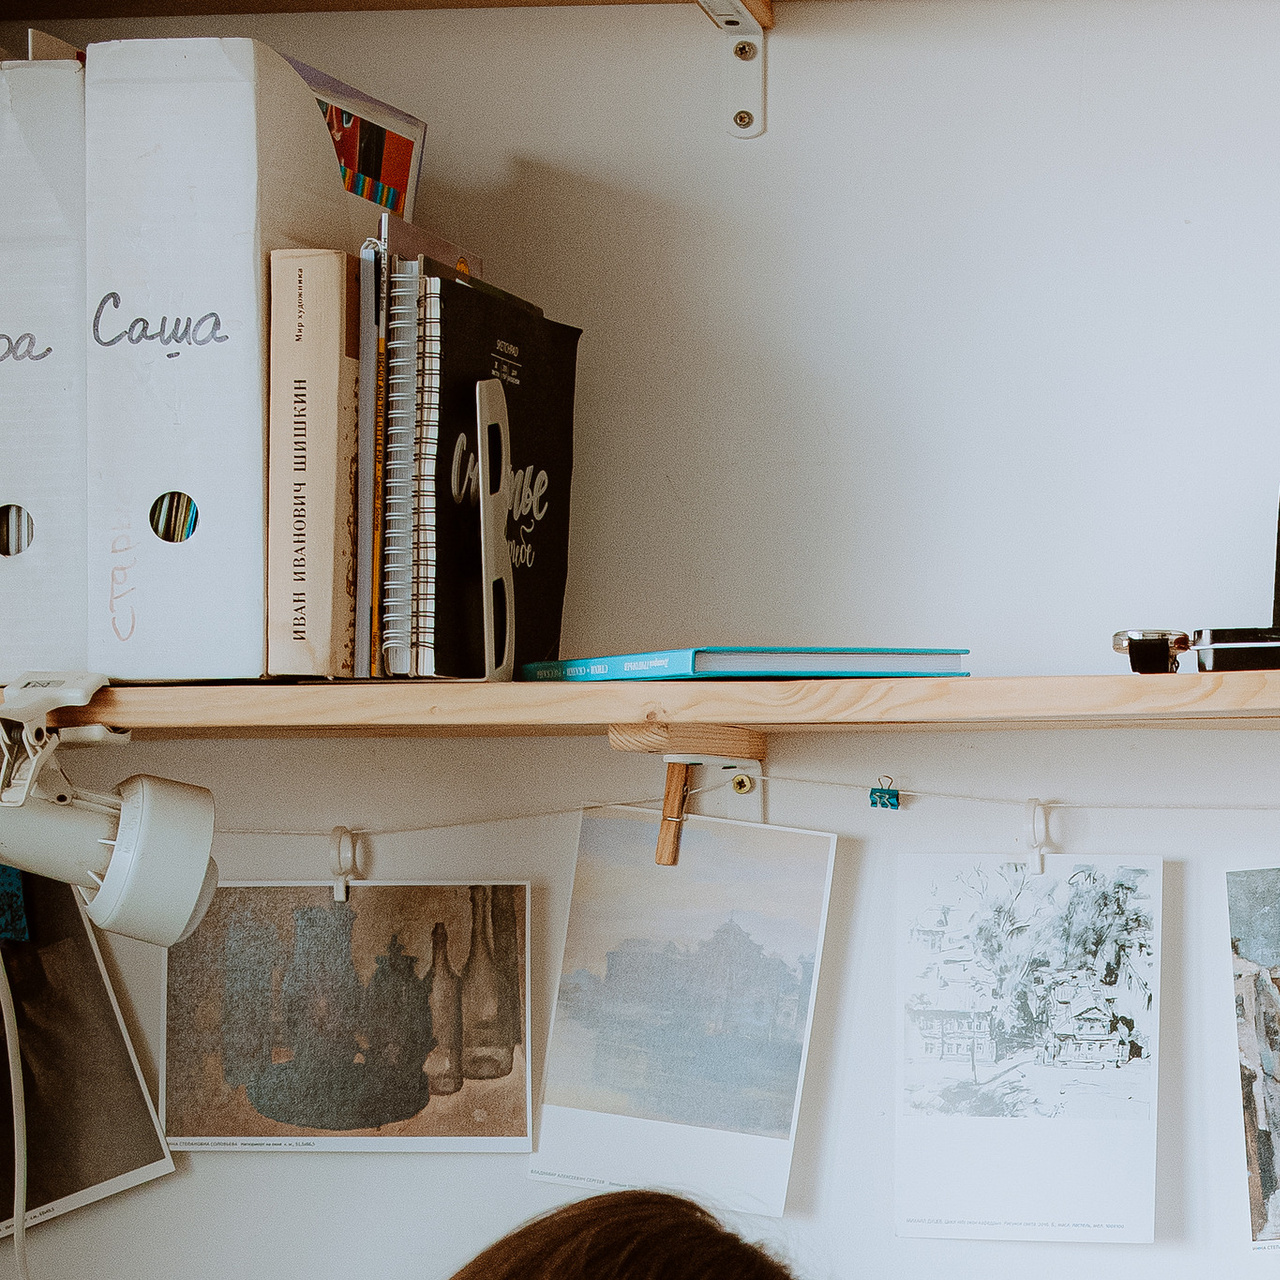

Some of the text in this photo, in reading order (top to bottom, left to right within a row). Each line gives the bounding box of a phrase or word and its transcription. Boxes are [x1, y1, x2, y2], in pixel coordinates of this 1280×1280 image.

[92, 291, 230, 347] Саша
[295, 268, 306, 342] Мир художника
[293, 379, 307, 472] ШИШКИН
[293, 482, 307, 582] ИВАНОВИЧ
[292, 592, 306, 641] ИВАН
